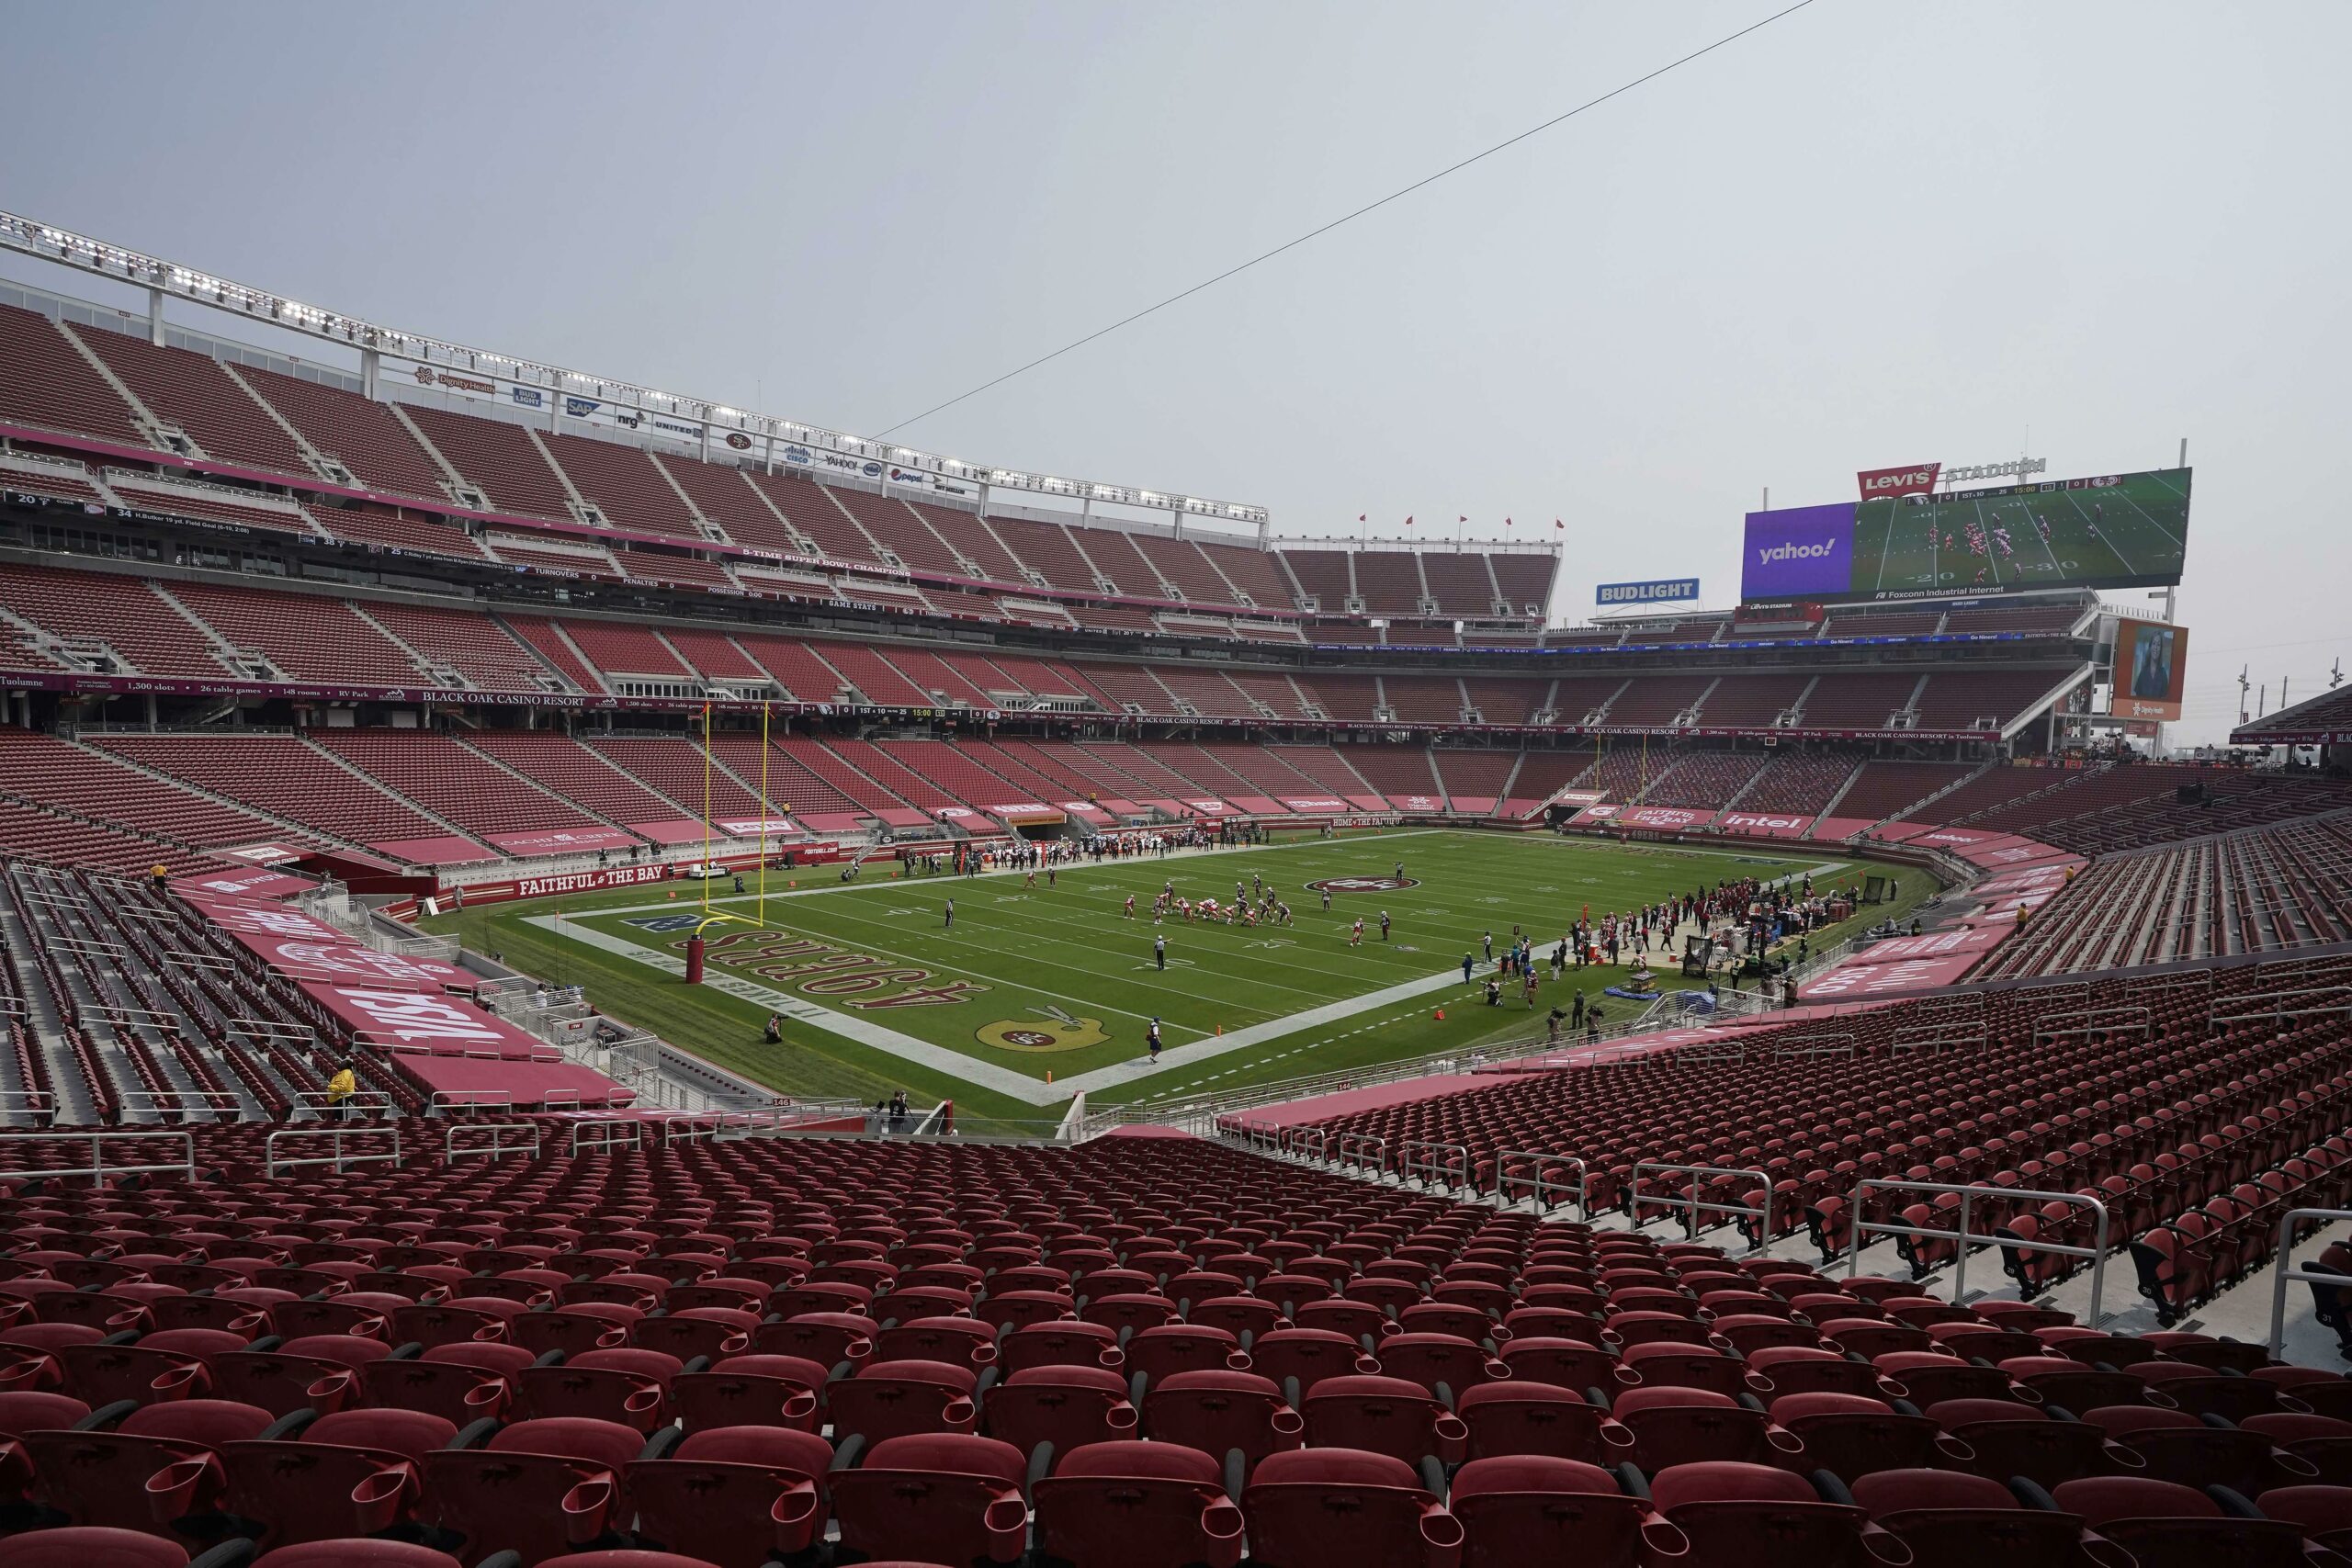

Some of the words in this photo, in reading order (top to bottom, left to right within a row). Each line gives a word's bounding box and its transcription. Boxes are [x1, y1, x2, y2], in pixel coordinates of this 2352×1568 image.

[439, 374, 468, 389] Dignity
[469, 382, 495, 394] Health
[515, 395, 540, 405] LIGHT
[518, 389, 537, 400] BUD
[568, 400, 593, 415] SAP
[617, 414, 639, 429] nrg
[655, 422, 692, 434] UNITED
[825, 455, 858, 471] YAHOO!
[1945, 457, 2047, 483] STADIUM
[901, 473, 922, 483] pepsi
[2013, 485, 2036, 494] 15:00
[18, 494, 36, 504] 20
[117, 508, 132, 518] 34
[323, 537, 335, 546] 38
[1759, 537, 1836, 564] yahoo!
[742, 548, 782, 559] 5-TIME
[785, 554, 820, 566] SUPER
[821, 559, 852, 570] BOWL
[854, 564, 911, 577] CHAMPIONS
[535, 568, 580, 579] TURNOVERS
[623, 578, 659, 587] PENALTIES
[707, 586, 744, 596] POSSESSION
[1889, 591, 1925, 599] Foxconn
[1926, 587, 1968, 597] Industrial
[1969, 585, 2005, 594] Internet
[829, 600, 851, 609] GAME
[853, 602, 876, 611] STATS
[925, 610, 952, 618] TURNOVERS
[0, 676, 44, 687] Tuolumne
[213, 685, 234, 694] table
[235, 687, 262, 695] games
[423, 691, 466, 703] BLACK
[468, 693, 494, 704] OAK
[496, 694, 540, 705] CASINO
[543, 696, 585, 706] RESORT
[1637, 809, 1695, 819] FAITHFUL
[1333, 818, 1353, 827] HOME
[501, 837, 553, 847] CACHE
[576, 831, 624, 840] CREEK
[1632, 829, 1660, 840] 49ERS
[278, 855, 300, 864] STADIUM
[234, 873, 290, 886] TOYOTA
[519, 874, 595, 896] FAITHFUL
[606, 867, 636, 885] THE
[637, 865, 663, 881] BAY
[334, 988, 504, 1042] VISA
[1338, 1082, 1351, 1090] 144
[773, 1099, 790, 1107] 146
